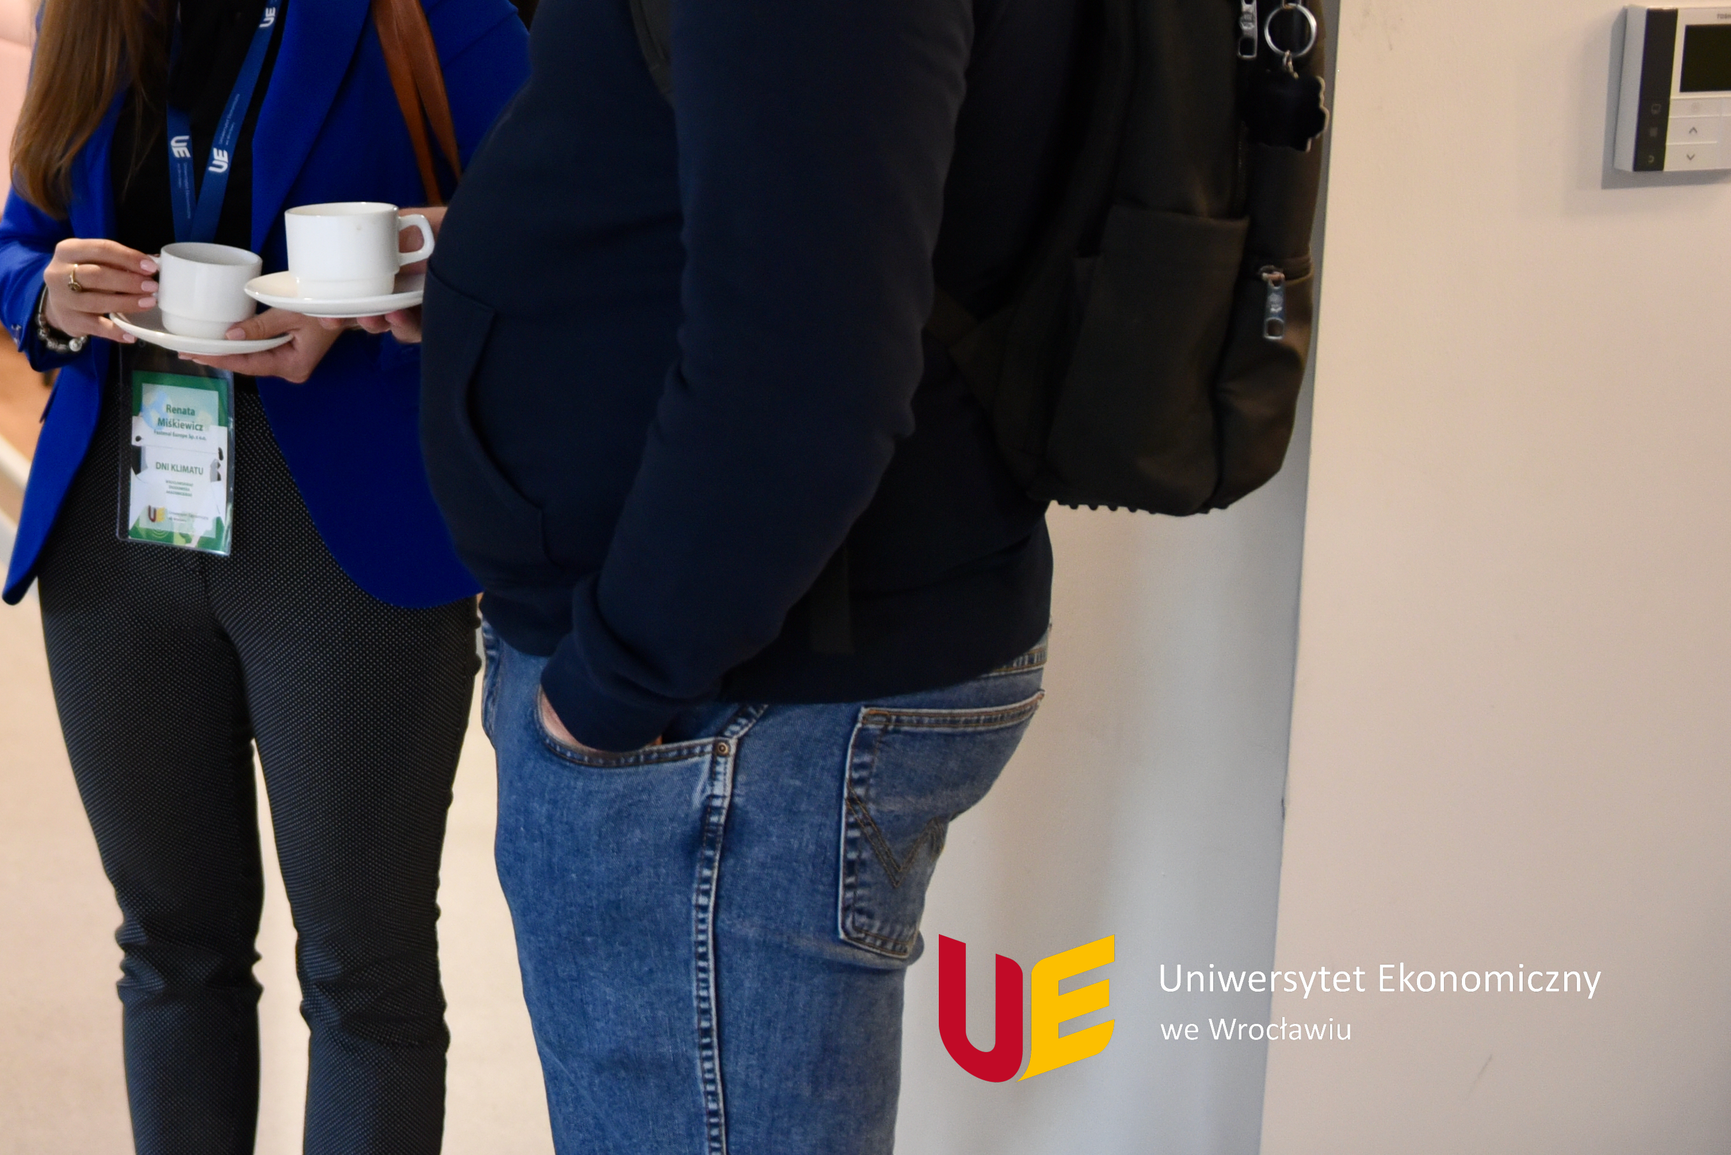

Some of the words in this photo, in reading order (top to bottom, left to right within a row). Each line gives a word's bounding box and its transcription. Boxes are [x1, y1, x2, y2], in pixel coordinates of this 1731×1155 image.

[259, 6, 276, 29] UE
[170, 134, 192, 160] UE
[208, 147, 230, 174] UE
[165, 403, 196, 417] Renata
[157, 417, 204, 432] Miśkiewicz
[155, 461, 170, 471] DNI
[170, 463, 204, 476] KLIMATU
